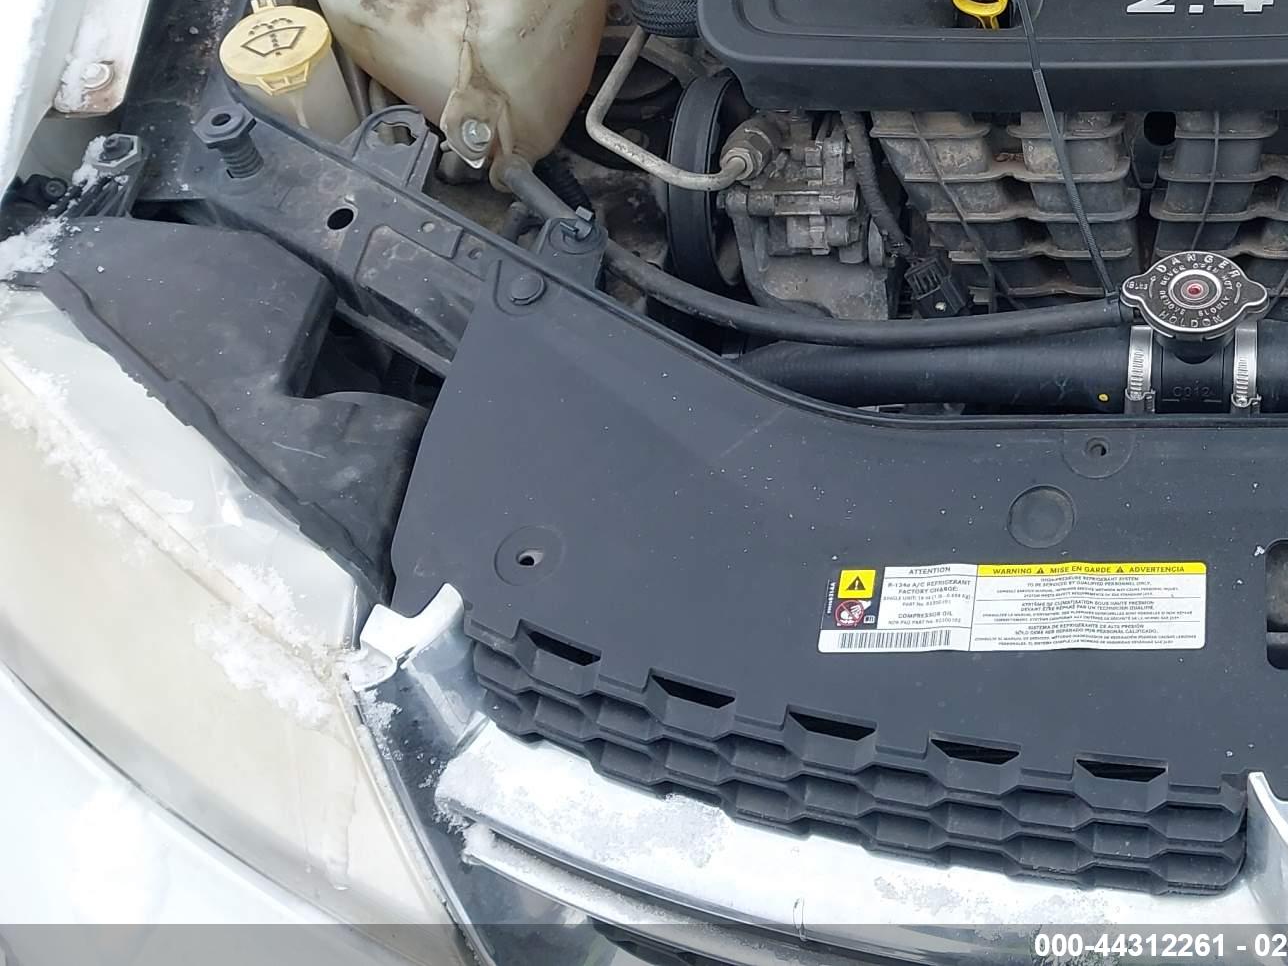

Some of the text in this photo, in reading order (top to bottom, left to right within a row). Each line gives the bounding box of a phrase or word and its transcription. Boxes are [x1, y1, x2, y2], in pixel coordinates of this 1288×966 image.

[1156, 253, 1241, 278] DANGER
[909, 567, 951, 575] ATTENTION
[992, 567, 1032, 575] WARNING
[1049, 566, 1070, 574] MISE
[1084, 565, 1111, 573] GARDE
